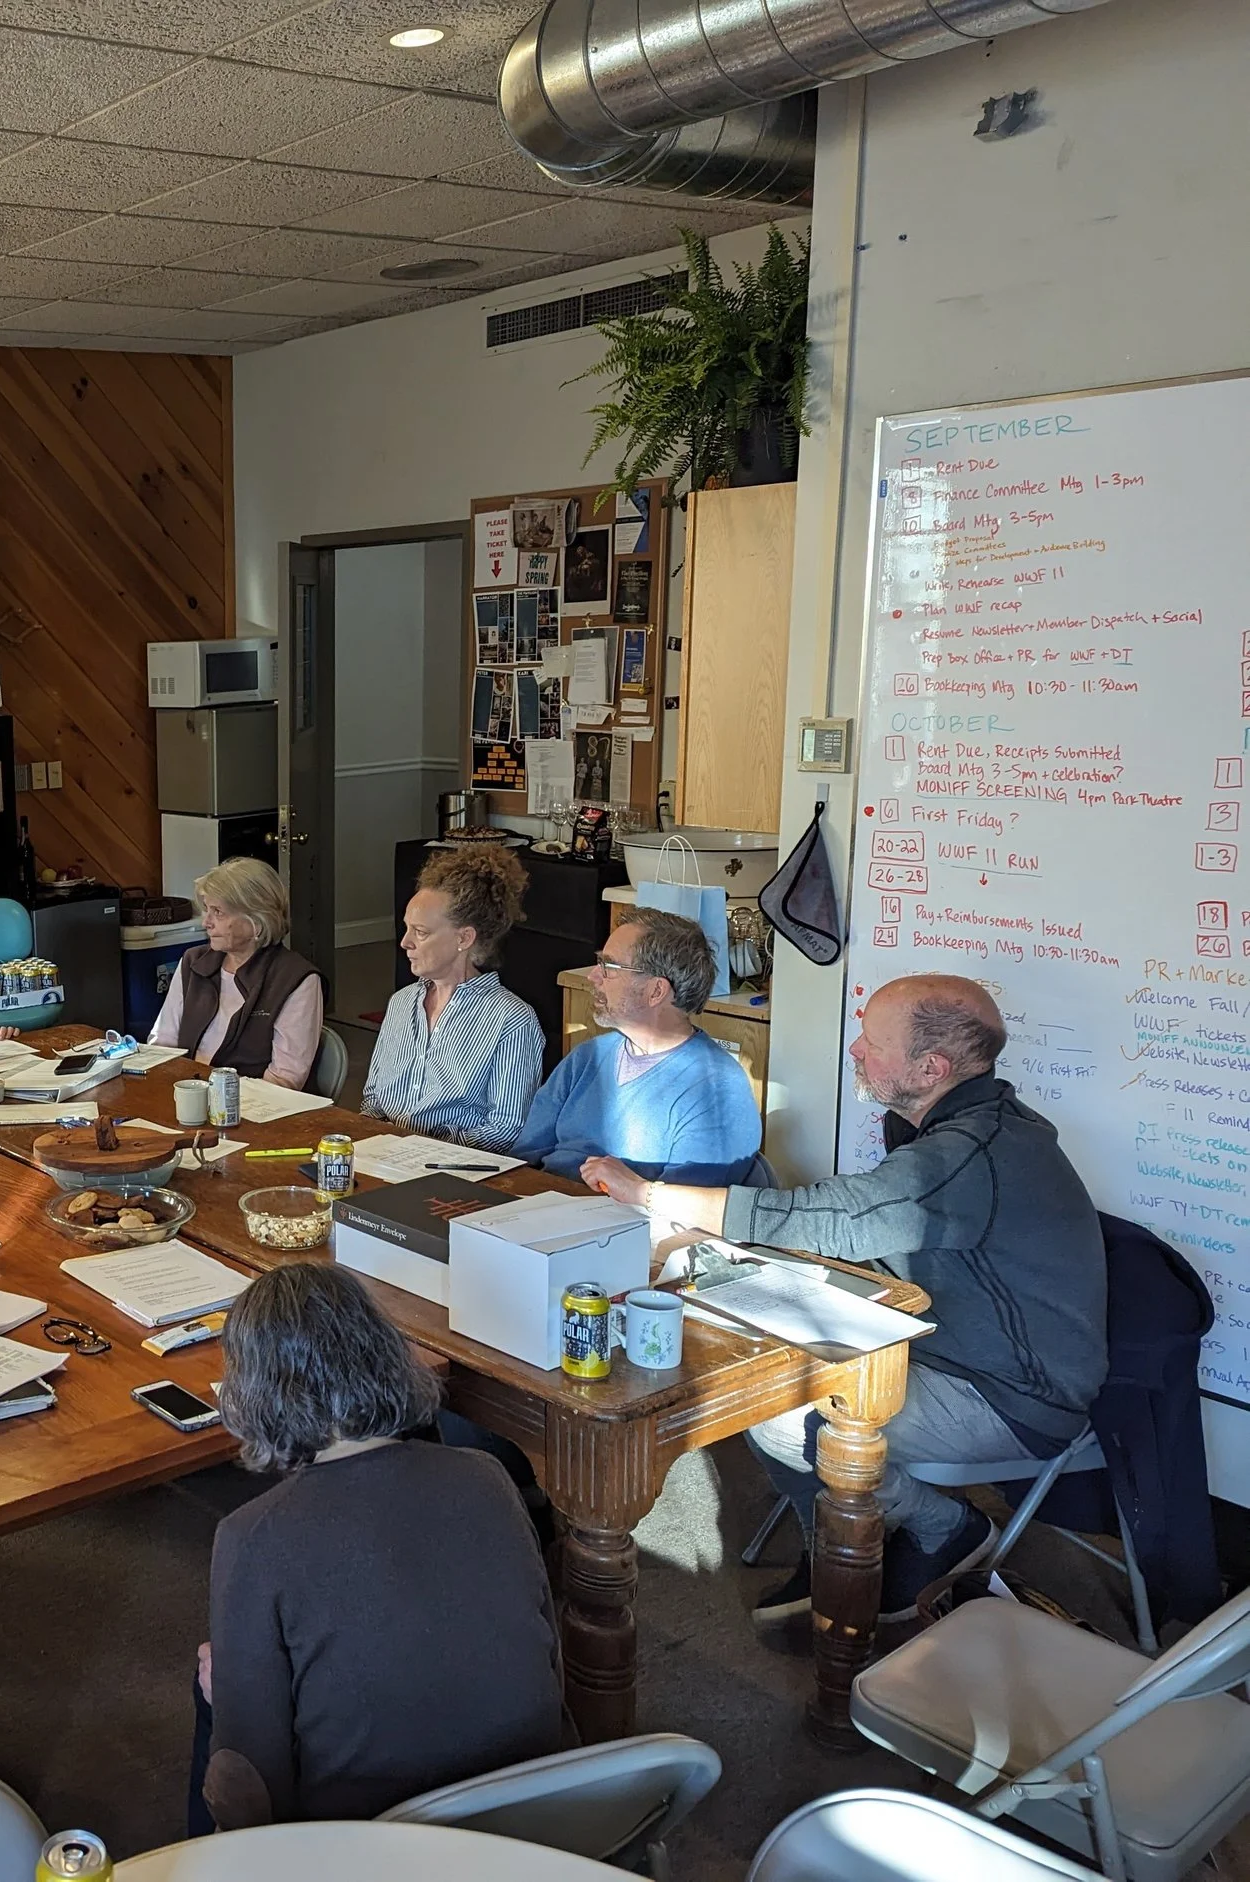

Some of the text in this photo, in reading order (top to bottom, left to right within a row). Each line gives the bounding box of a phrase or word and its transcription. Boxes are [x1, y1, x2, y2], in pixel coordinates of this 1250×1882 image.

[905, 415, 1090, 453] SEPTEMBER
[936, 461, 963, 476] Rent
[968, 459, 999, 472] Due
[933, 487, 980, 501] Finance
[986, 479, 1050, 498] Committee
[1060, 475, 1083, 494] Mtg
[486, 518, 508, 527] PLEASE
[933, 517, 966, 532] Board
[974, 513, 1000, 534] Mtg
[525, 571, 550, 584] SPRING
[958, 577, 1004, 590] Rehearse
[1013, 568, 1046, 584] WWF
[922, 600, 1022, 616] Plan WWF recap
[922, 628, 964, 640] Resume
[972, 624, 1028, 637] Newsletter
[1036, 616, 1087, 631] Member
[1091, 612, 1148, 630] Dispatch
[1163, 609, 1203, 624] Social
[922, 651, 942, 667] Prep
[1017, 649, 1036, 661] PR
[1042, 648, 1060, 662] for
[1070, 648, 1096, 661] WWF
[897, 677, 915, 693] 26
[925, 677, 986, 699] Bookkeeping
[992, 680, 1015, 700] Mtg
[892, 712, 1015, 734] OCTOBER
[917, 740, 950, 758] Rent
[995, 744, 1049, 762] Receipts
[1054, 744, 1121, 761] Submitted
[918, 760, 951, 776] Board
[958, 764, 984, 781] Mtg
[916, 780, 1183, 807] MONIFF SCREENING 4pm Park Theatre
[911, 805, 949, 822] First
[957, 809, 1004, 836] Friday
[1214, 804, 1232, 824] 3
[877, 838, 919, 855] 20-22
[938, 842, 978, 861] WWF
[1008, 853, 1038, 870] RUN
[884, 898, 897, 914] 16
[916, 904, 935, 926] Pay
[945, 907, 1034, 933] Reimbursements
[1042, 918, 1083, 941] Issued
[1202, 904, 1220, 924] 18
[876, 929, 894, 944] 24
[913, 931, 988, 960] Bookkeeping
[995, 939, 1024, 963] Mtg
[1199, 936, 1226, 953] 26
[1144, 959, 1171, 982] PR
[1189, 964, 1250, 987] Marke
[1134, 988, 1239, 1014] Welcome Fall
[1134, 1013, 1246, 1044] WWF tickets
[1174, 1079, 1222, 1100] Releases
[326, 1165, 349, 1177] POLAR
[348, 1212, 407, 1241] Lindenmeyr Envelope
[1205, 1270, 1223, 1286] PR
[563, 1321, 589, 1343] POLAR
